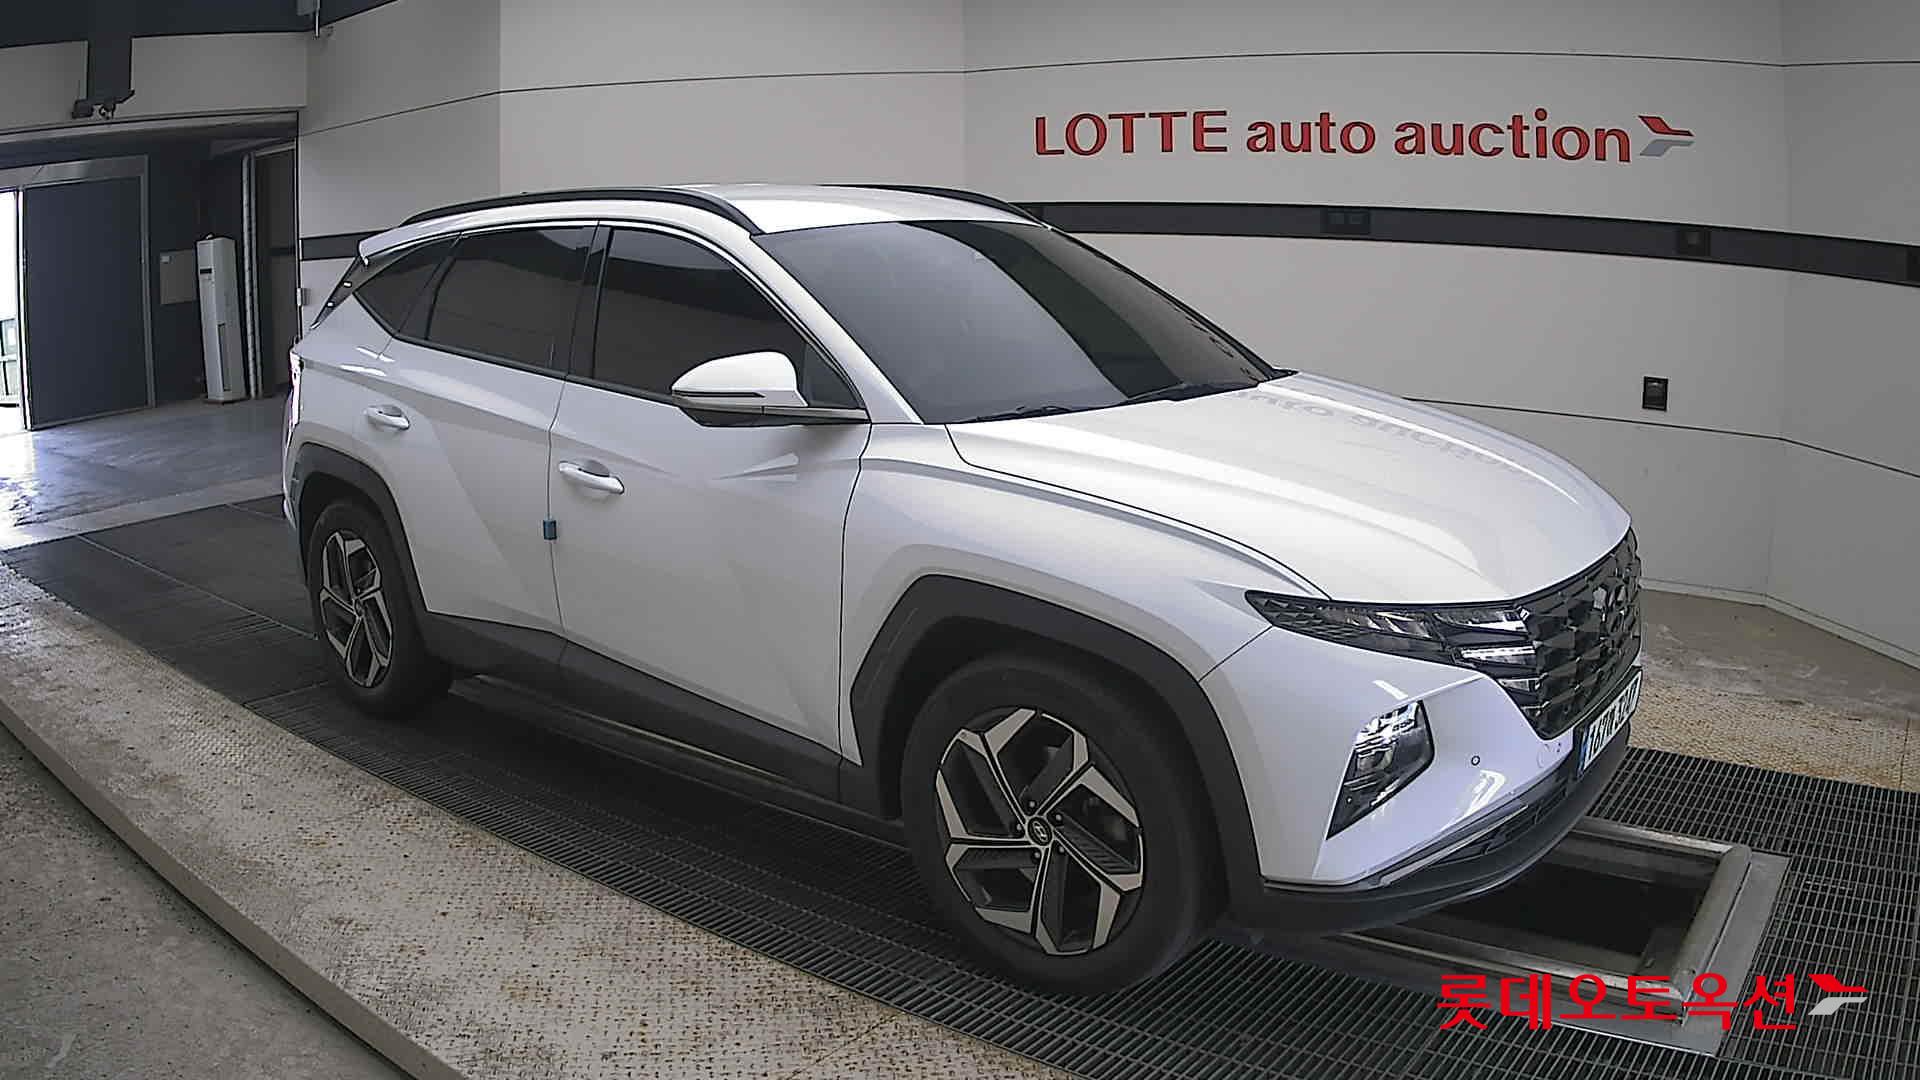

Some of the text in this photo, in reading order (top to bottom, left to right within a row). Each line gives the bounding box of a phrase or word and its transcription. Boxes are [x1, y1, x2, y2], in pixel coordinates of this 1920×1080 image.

[1034, 109, 1632, 162] LOTTE auto auction
